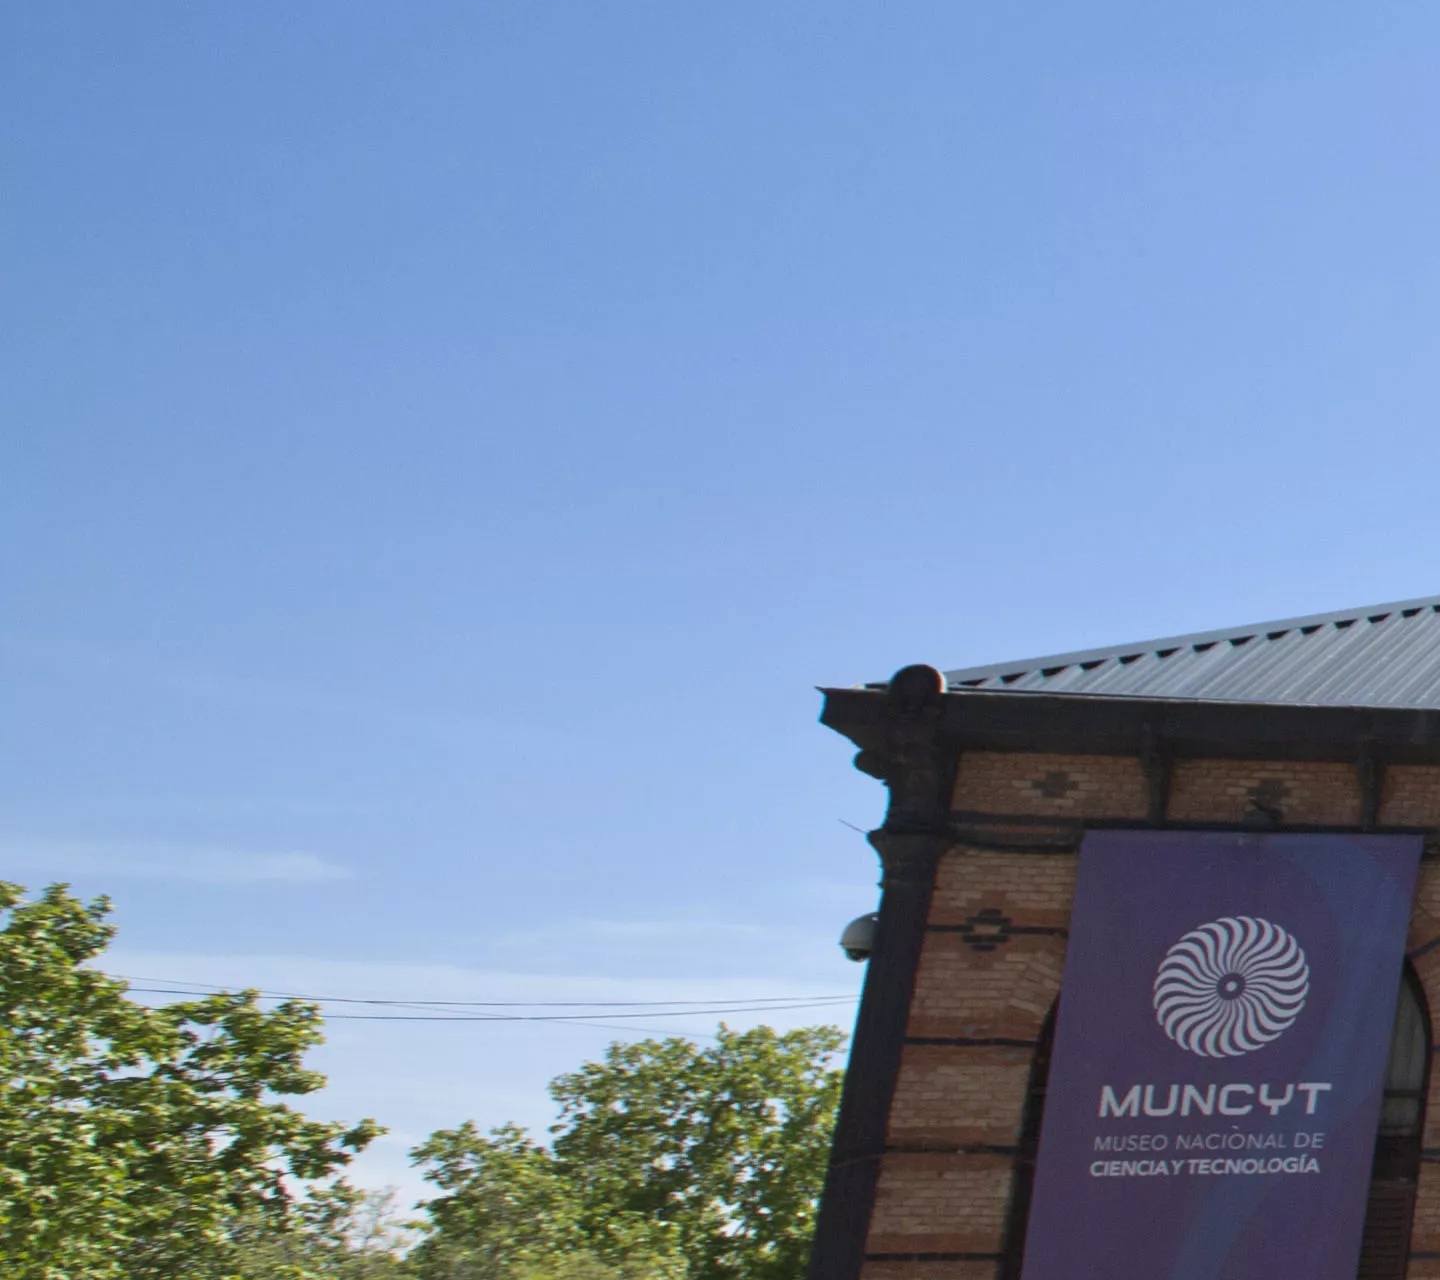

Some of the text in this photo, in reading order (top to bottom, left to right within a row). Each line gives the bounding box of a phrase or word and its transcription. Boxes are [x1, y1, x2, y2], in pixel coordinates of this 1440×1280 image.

[1098, 1082, 1332, 1118] MUNCYT
[1093, 1132, 1325, 1152] MUSEO NACIONAL DE
[1089, 1154, 1320, 1177] CIENCIA Y TECNOLOGÍA
